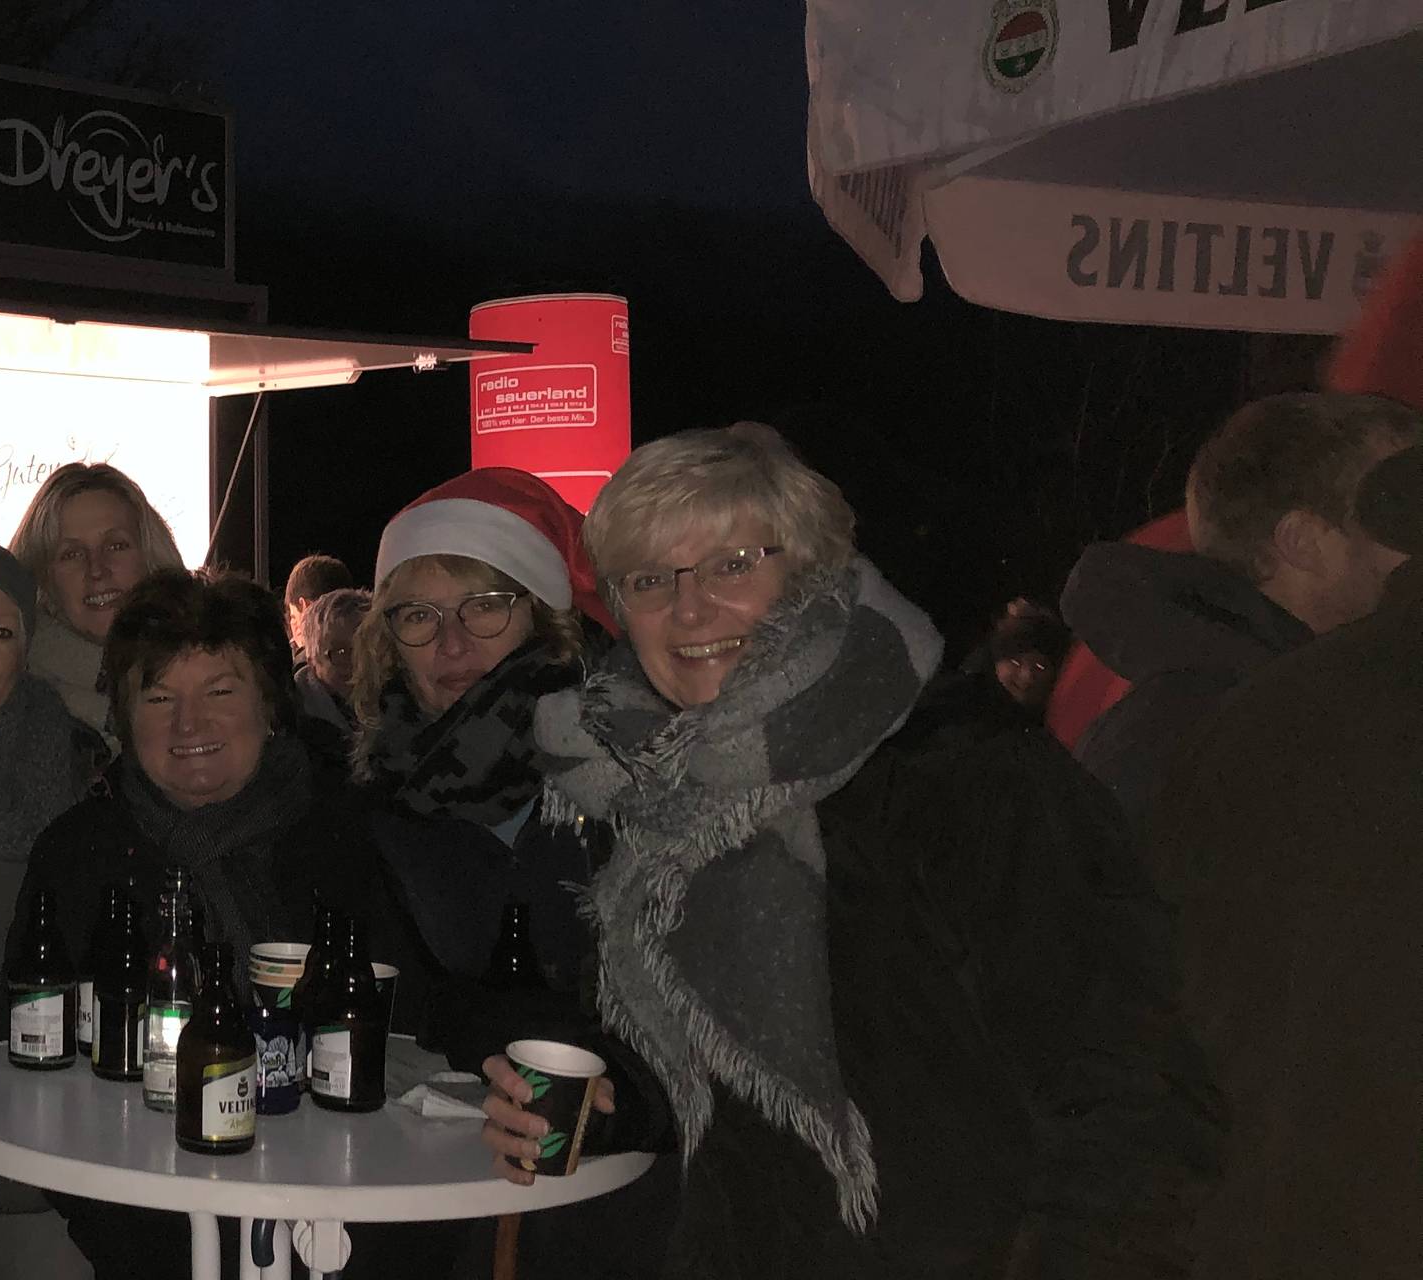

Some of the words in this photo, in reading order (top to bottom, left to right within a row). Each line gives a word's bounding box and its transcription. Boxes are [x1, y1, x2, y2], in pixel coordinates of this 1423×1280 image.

[480, 376, 519, 392] radio
[495, 386, 587, 404] sauerland
[498, 418, 511, 426] von
[530, 415, 544, 424] Der
[547, 413, 570, 422] beste
